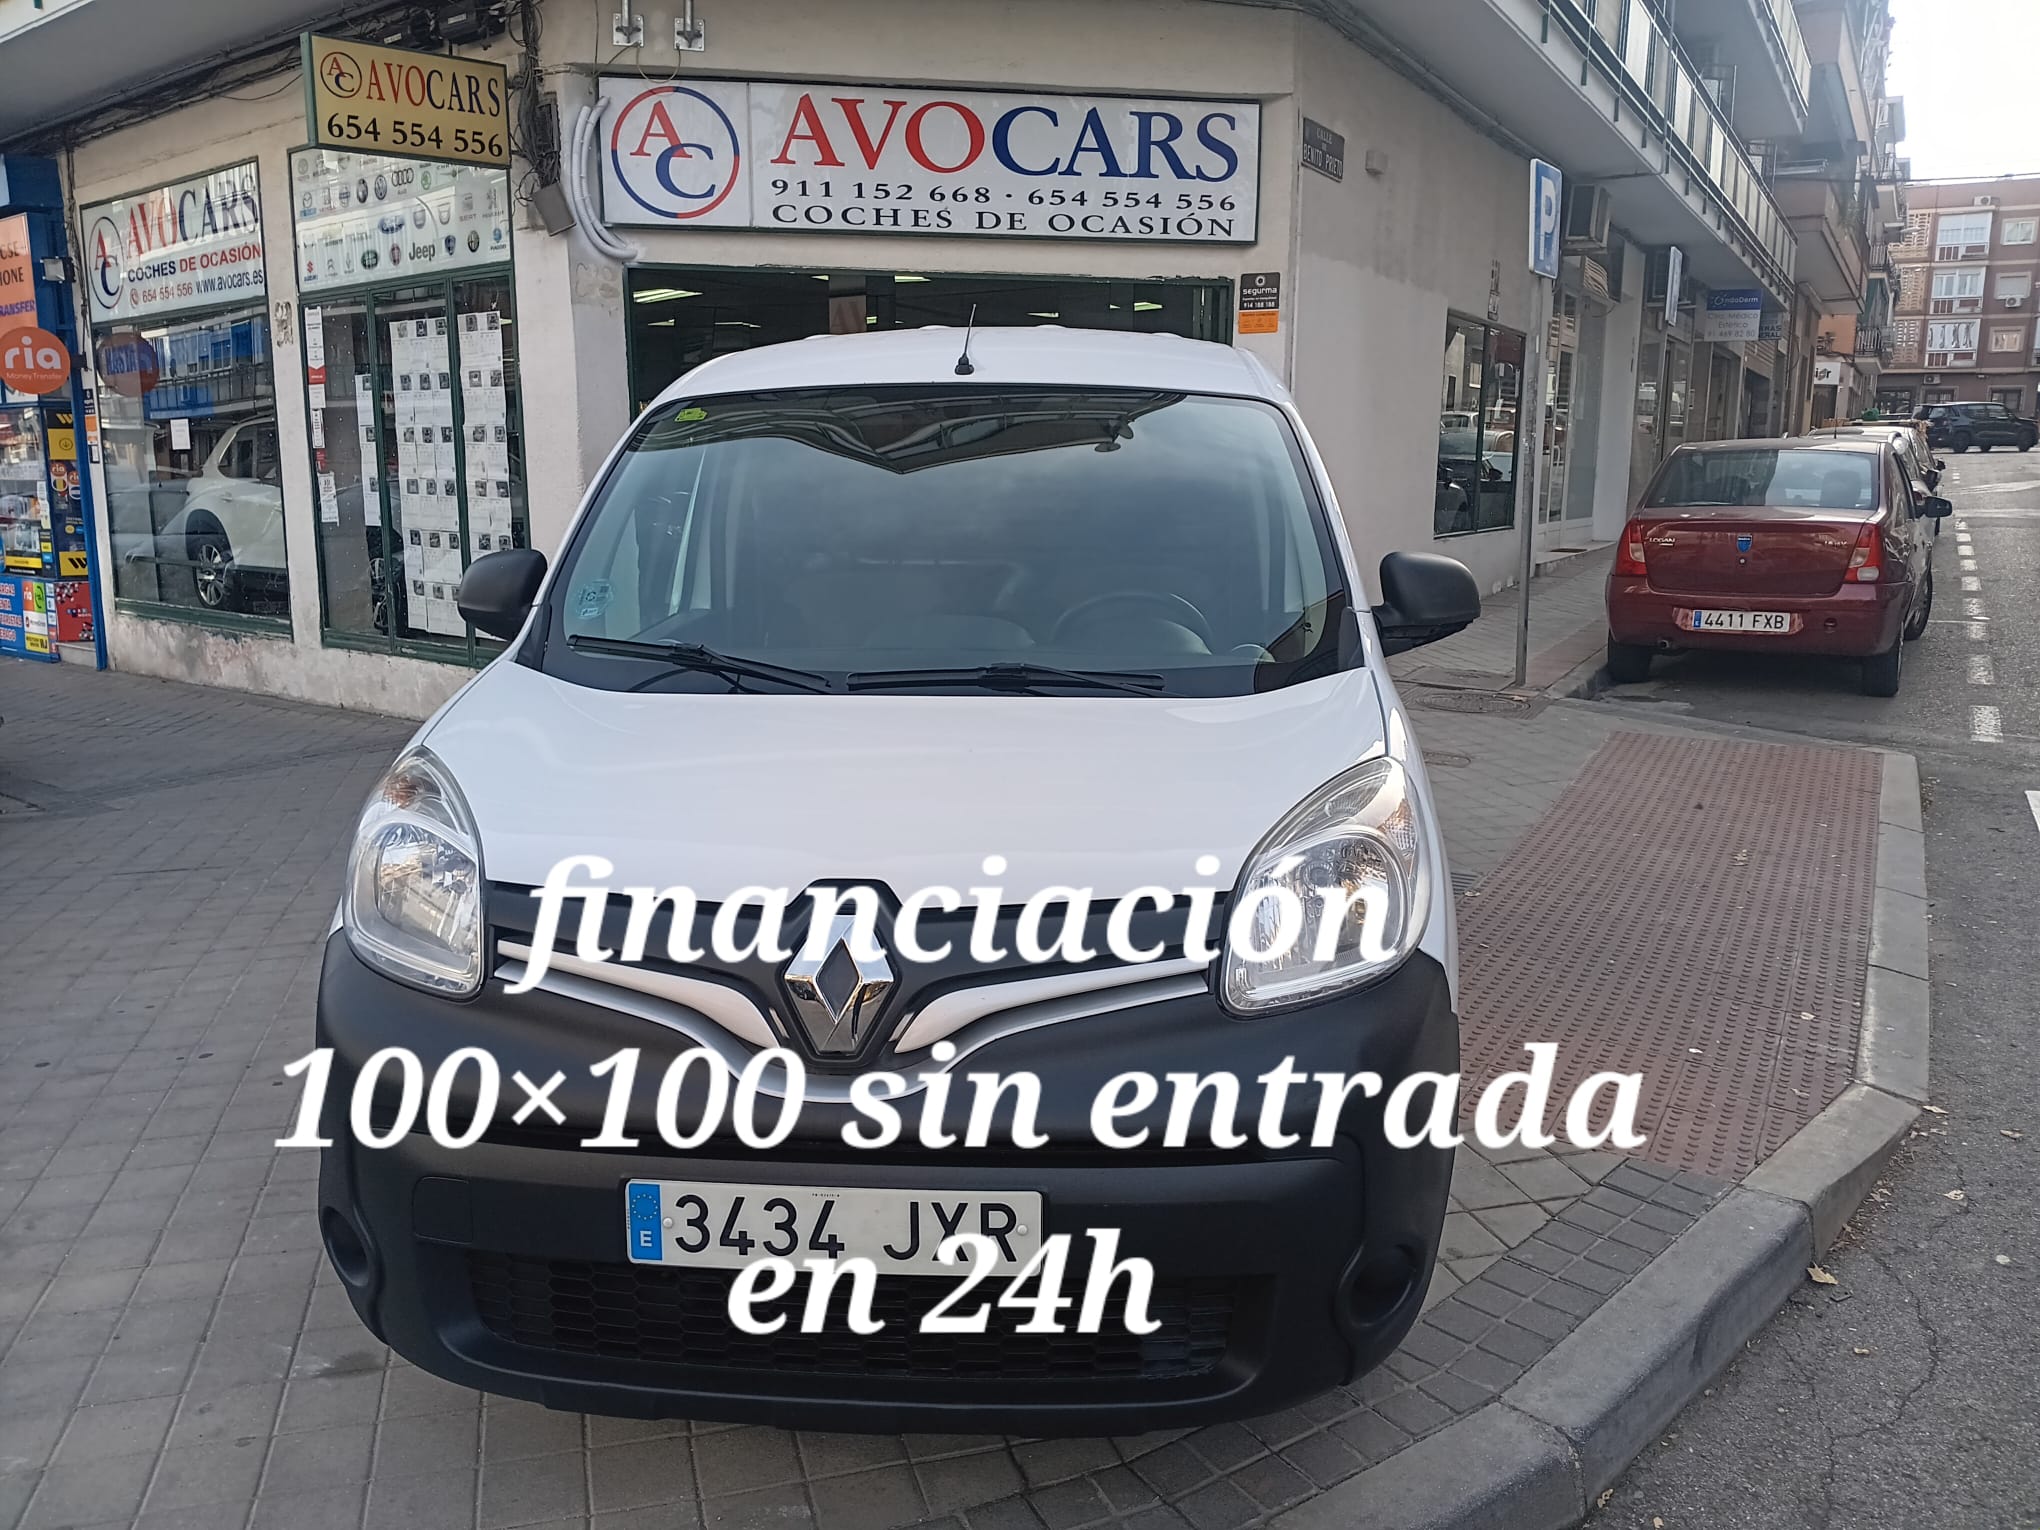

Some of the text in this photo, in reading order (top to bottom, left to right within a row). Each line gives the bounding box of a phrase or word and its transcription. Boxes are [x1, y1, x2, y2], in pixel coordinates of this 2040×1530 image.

[366, 59, 500, 117] AVOCARS
[327, 112, 503, 157] 654 554 556
[770, 93, 1238, 183] AVOCARS
[1303, 143, 1343, 177] BENITO PRIETO
[771, 179, 1236, 211] 911 152 668 654 554 556
[126, 173, 259, 260] AVOCARS
[772, 204, 1235, 237] COCHES DE OCASIÓN
[1539, 175, 1557, 261] P
[128, 242, 262, 283] COCHES DE OCASIÓN
[408, 241, 436, 262] Jeep
[142, 269, 264, 303] 654 554 556 www.avocars.es
[1242, 287, 1278, 296] segurma
[4, 335, 62, 370] ria
[1704, 612, 1784, 629] 4411 FXB
[639, 1229, 653, 1247] E
[675, 1194, 1018, 1263] 3434 JXR
